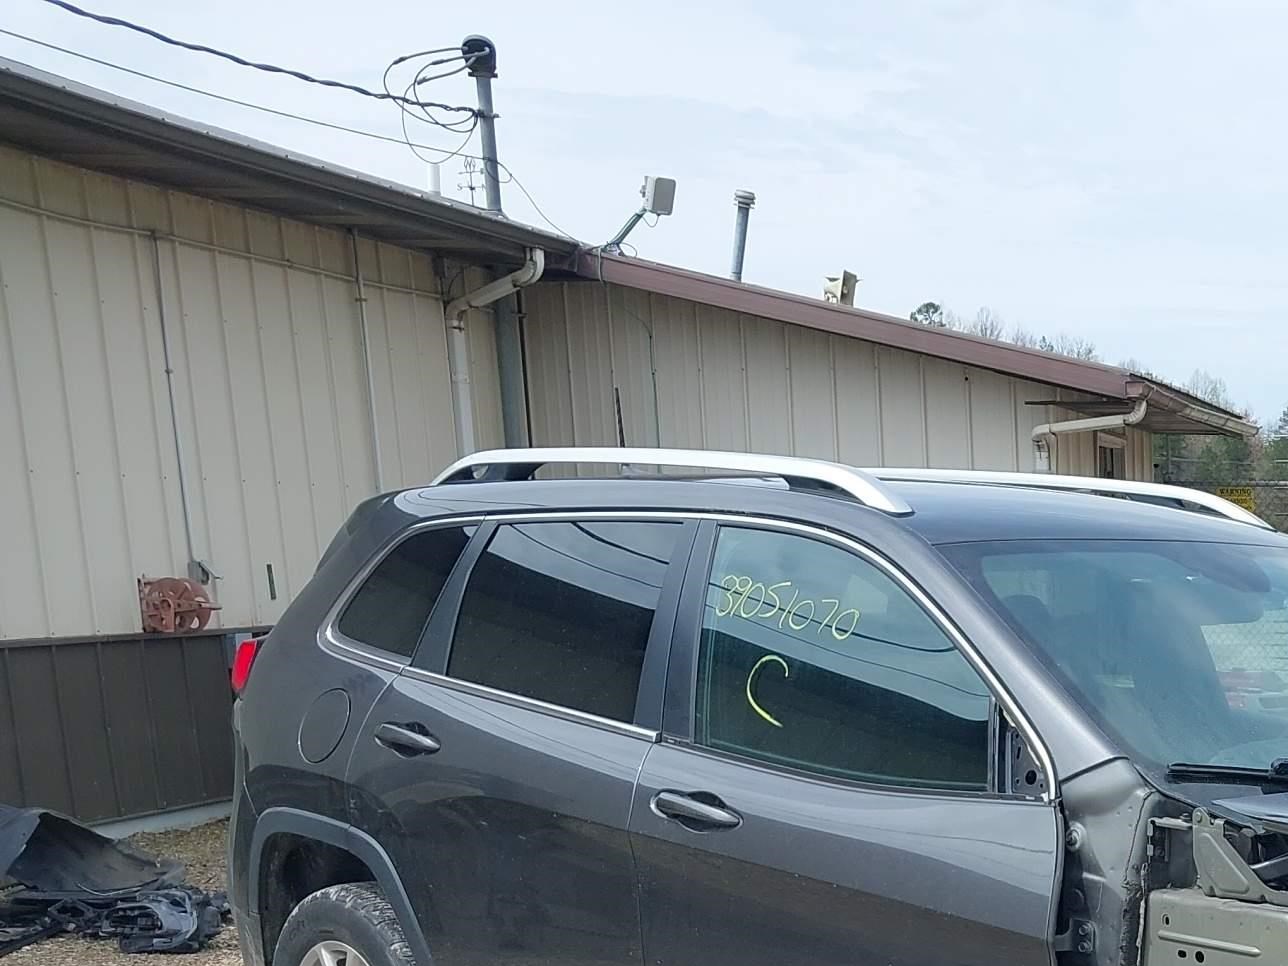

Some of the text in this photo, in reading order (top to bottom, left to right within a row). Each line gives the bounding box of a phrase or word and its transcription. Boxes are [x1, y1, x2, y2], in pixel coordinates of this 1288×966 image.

[1219, 488, 1252, 496] WARNING
[715, 574, 861, 641] 39051070
[746, 654, 790, 729] C
